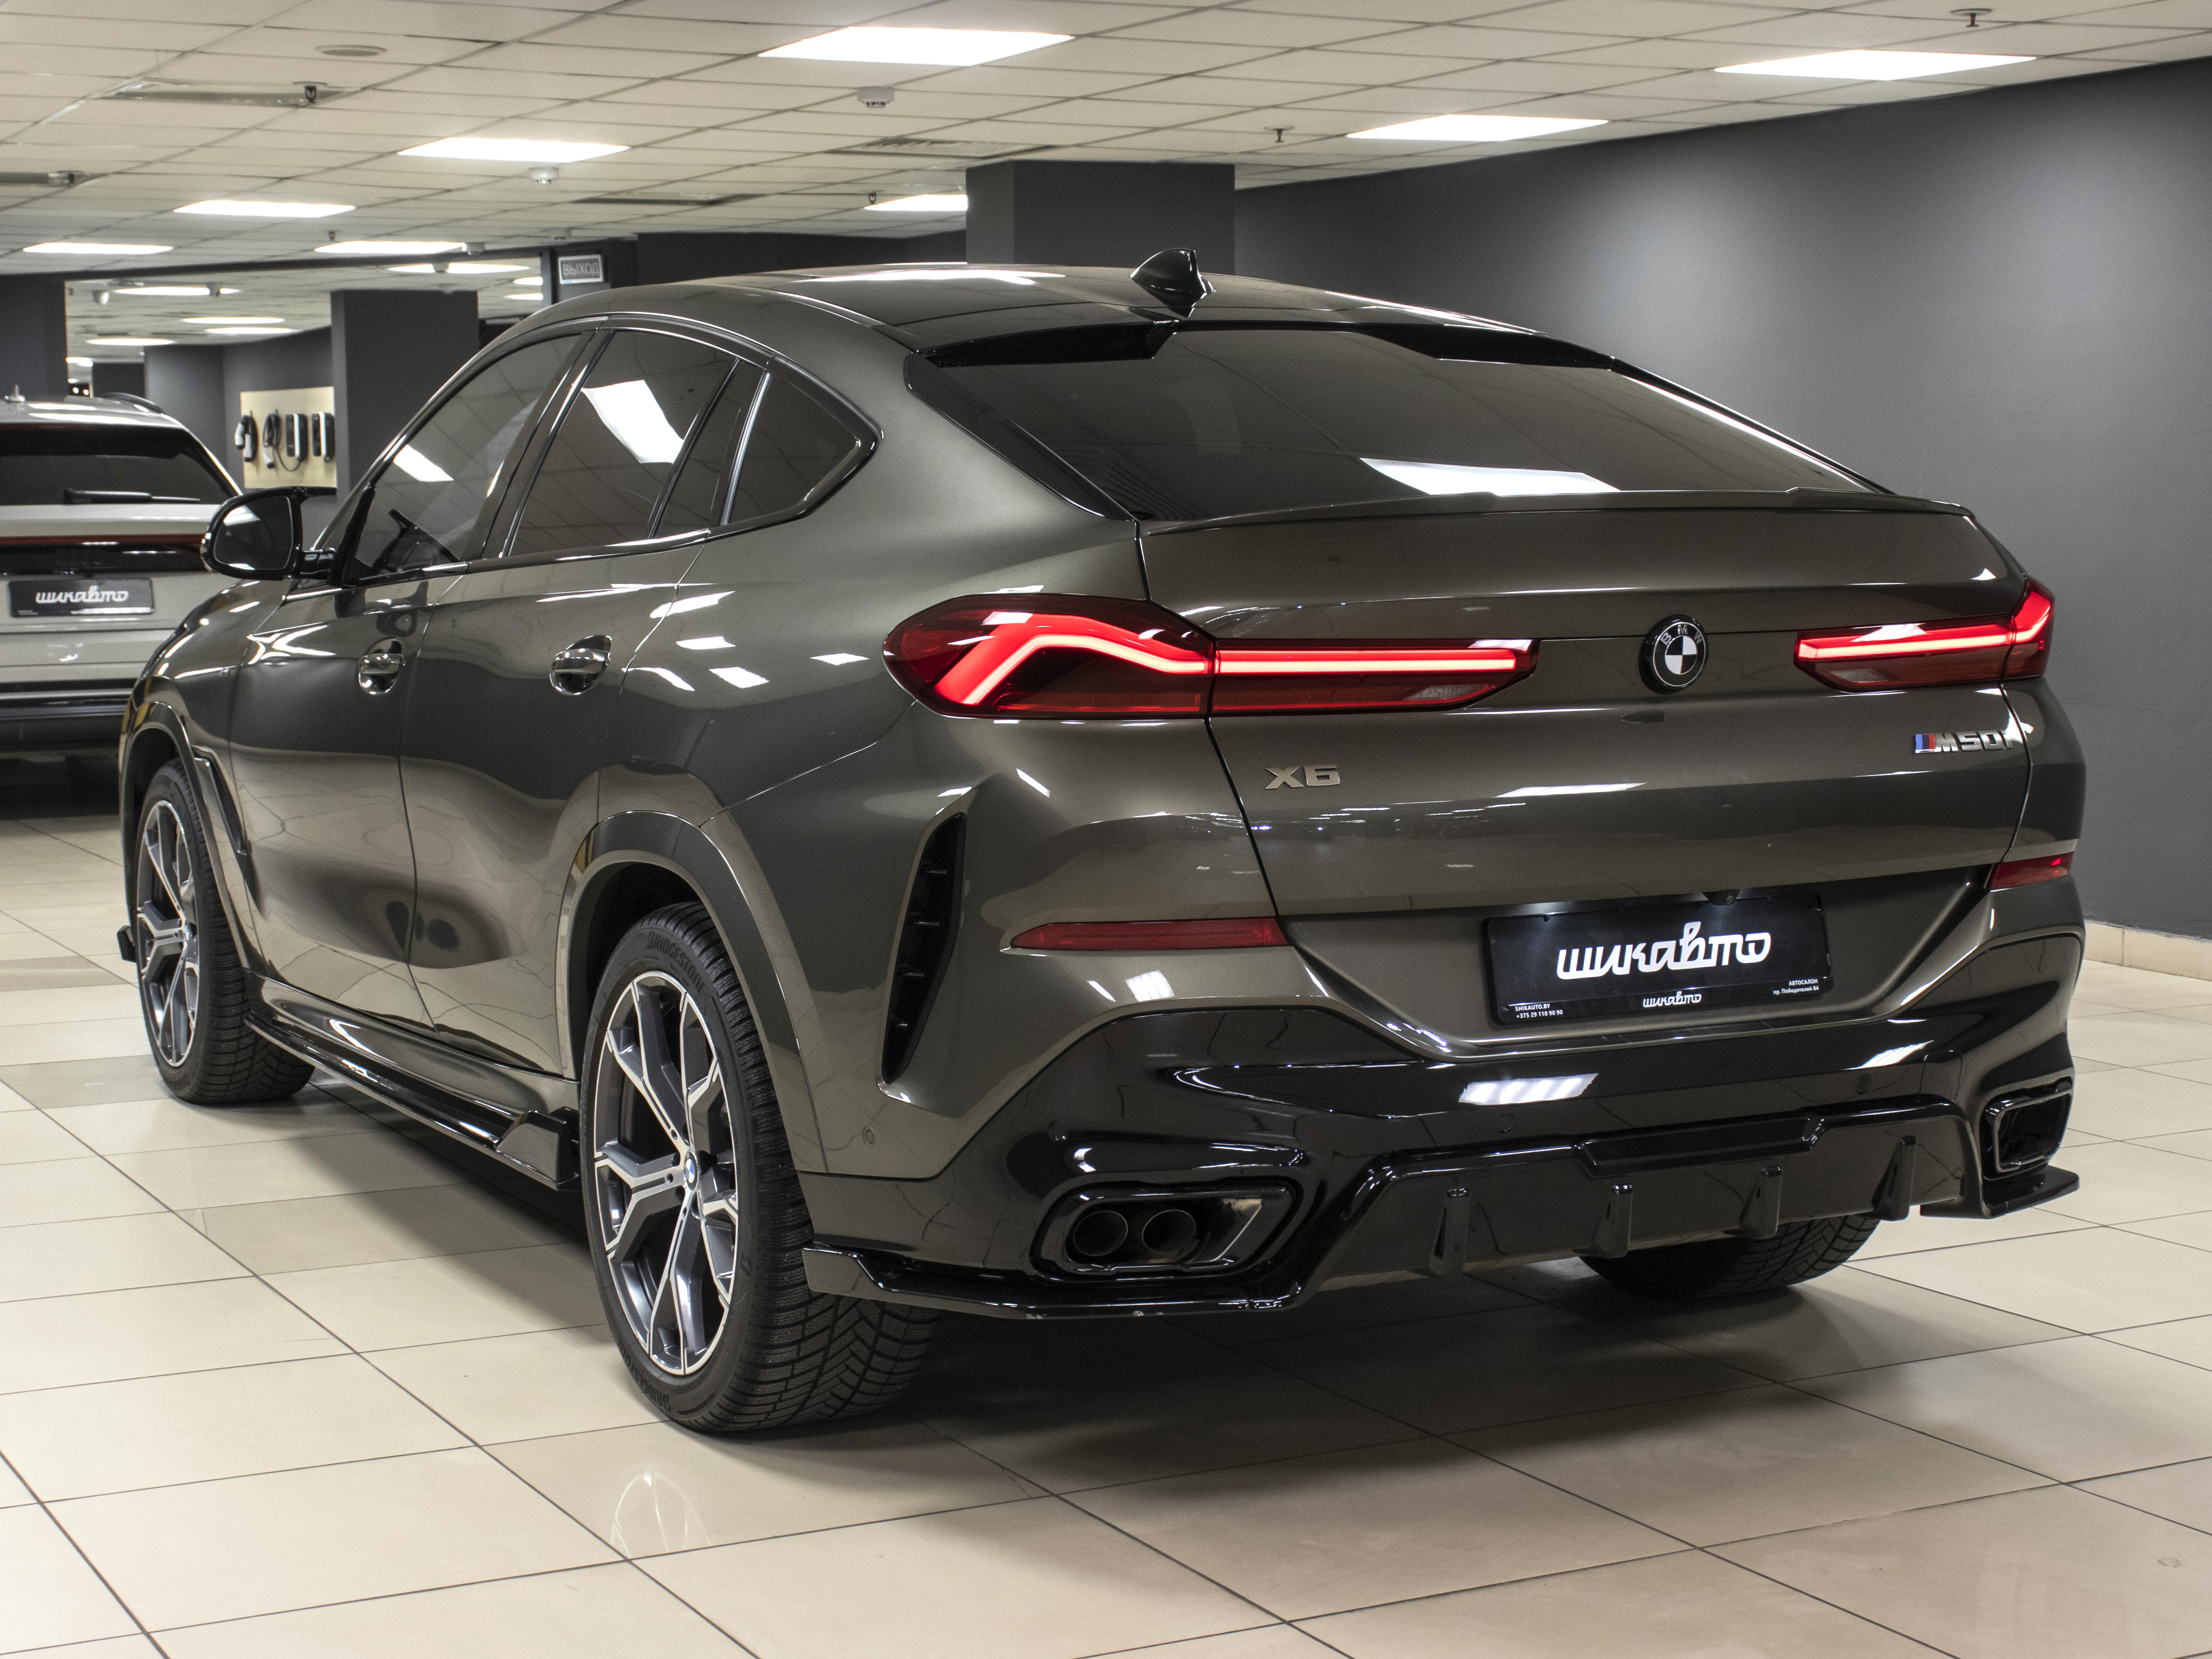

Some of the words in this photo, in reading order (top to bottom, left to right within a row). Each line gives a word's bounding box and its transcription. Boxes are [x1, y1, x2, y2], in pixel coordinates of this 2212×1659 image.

[563, 262, 599, 276] ВЫХОД
[1660, 624, 1702, 646] BMW
[1265, 764, 1340, 789] X6
[1556, 921, 1771, 980] шикавто
[646, 931, 707, 998] BRIDGESTONE
[1515, 1003, 1550, 1012] SHIKAUTO.BY
